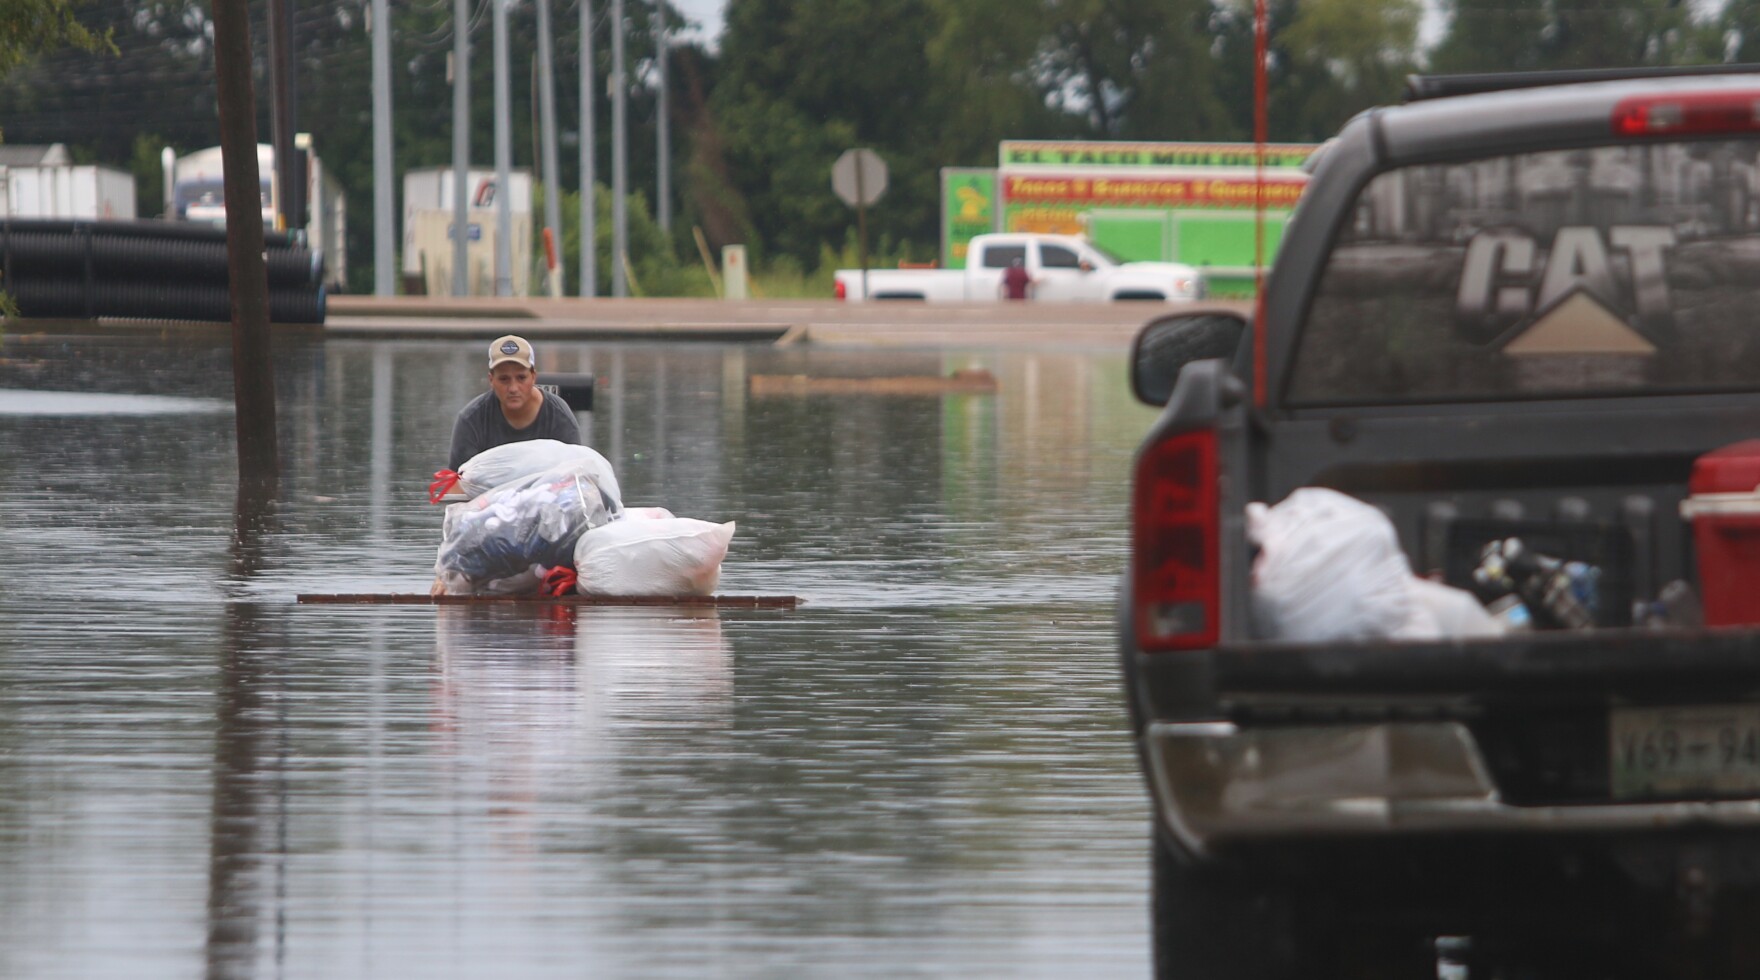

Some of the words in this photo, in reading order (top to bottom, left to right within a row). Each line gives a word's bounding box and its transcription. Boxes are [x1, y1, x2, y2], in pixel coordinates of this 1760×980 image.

[1011, 150, 1047, 163] EL
[1058, 151, 1139, 164] TACO
[1457, 225, 1677, 313] CAT
